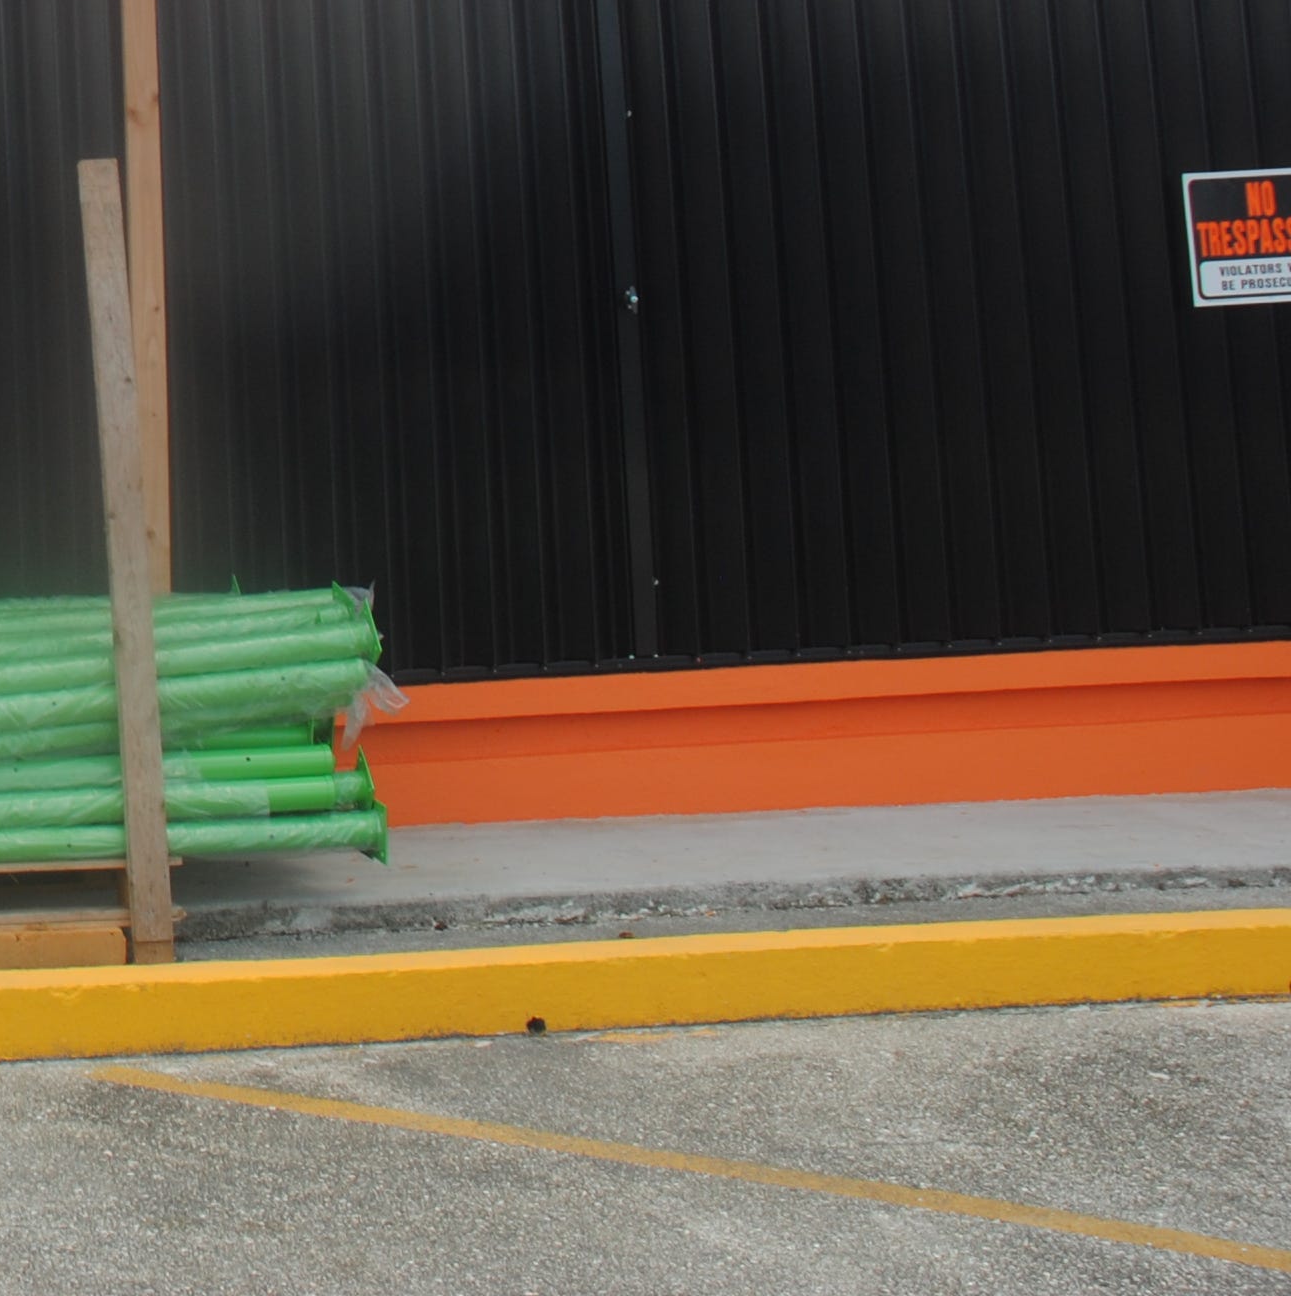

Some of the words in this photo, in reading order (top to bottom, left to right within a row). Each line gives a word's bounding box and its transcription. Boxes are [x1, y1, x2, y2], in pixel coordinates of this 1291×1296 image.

[1245, 180, 1277, 217] NO
[1219, 263, 1282, 277] VIOLATORS
[1221, 280, 1235, 291] BE
